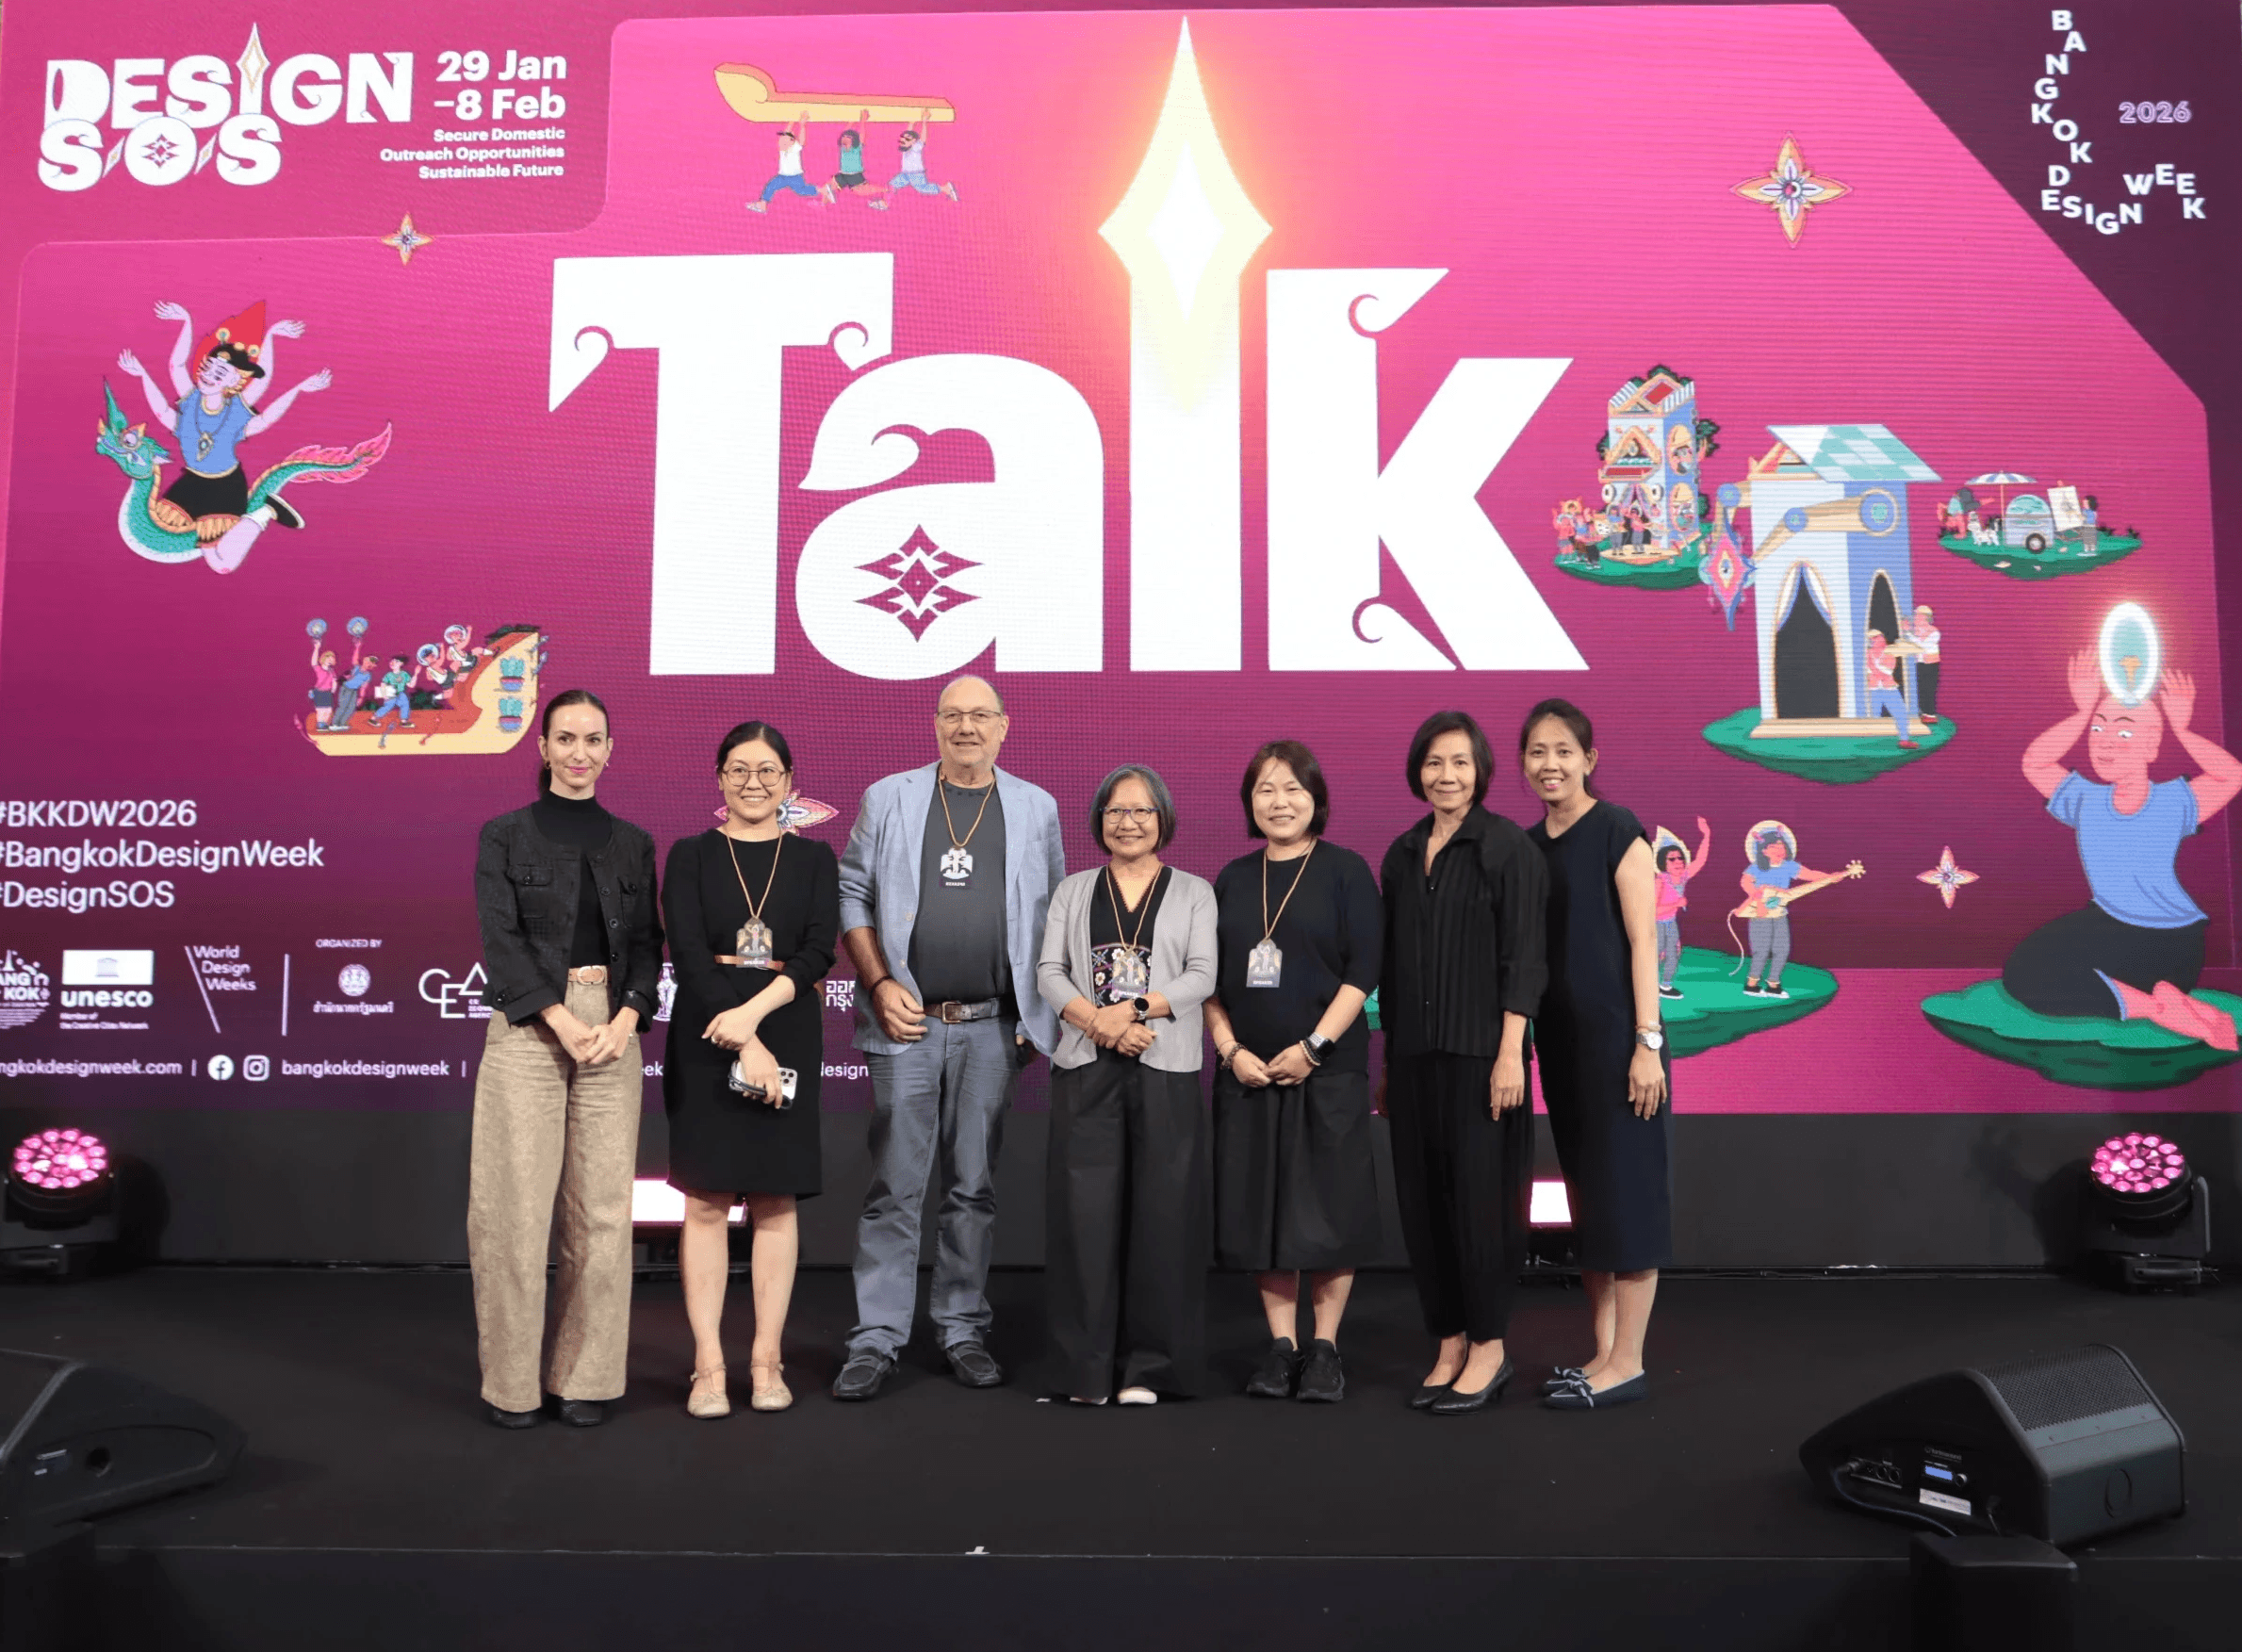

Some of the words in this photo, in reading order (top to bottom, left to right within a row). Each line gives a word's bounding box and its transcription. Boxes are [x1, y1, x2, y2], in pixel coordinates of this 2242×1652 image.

[435, 50, 490, 82] 29
[498, 49, 567, 81] Jan
[44, 22, 414, 130] DESIGN
[2031, 9, 2092, 164] BANGKOK
[491, 85, 566, 120] Feb
[2118, 101, 2192, 124] 2026
[433, 128, 489, 142] Secure
[491, 126, 565, 141] Domestic
[379, 147, 453, 162] Outreach
[455, 145, 565, 163] Opportunities
[418, 164, 511, 179] Sustainable
[512, 163, 565, 177] Future
[2040, 164, 2143, 235] DESIGN
[2121, 163, 2206, 220] WEEK
[548, 16, 1590, 679] Talk
[0, 880, 174, 914] DesignSOS
[193, 945, 239, 958] World
[316, 939, 368, 948] ORGANIZED
[369, 939, 382, 948] BY
[202, 960, 251, 977] Design
[205, 977, 257, 990] Weeks
[4, 986, 41, 1000] KOK
[60, 990, 155, 1008] unesco
[282, 1059, 450, 1078] bangkokdesignweek
